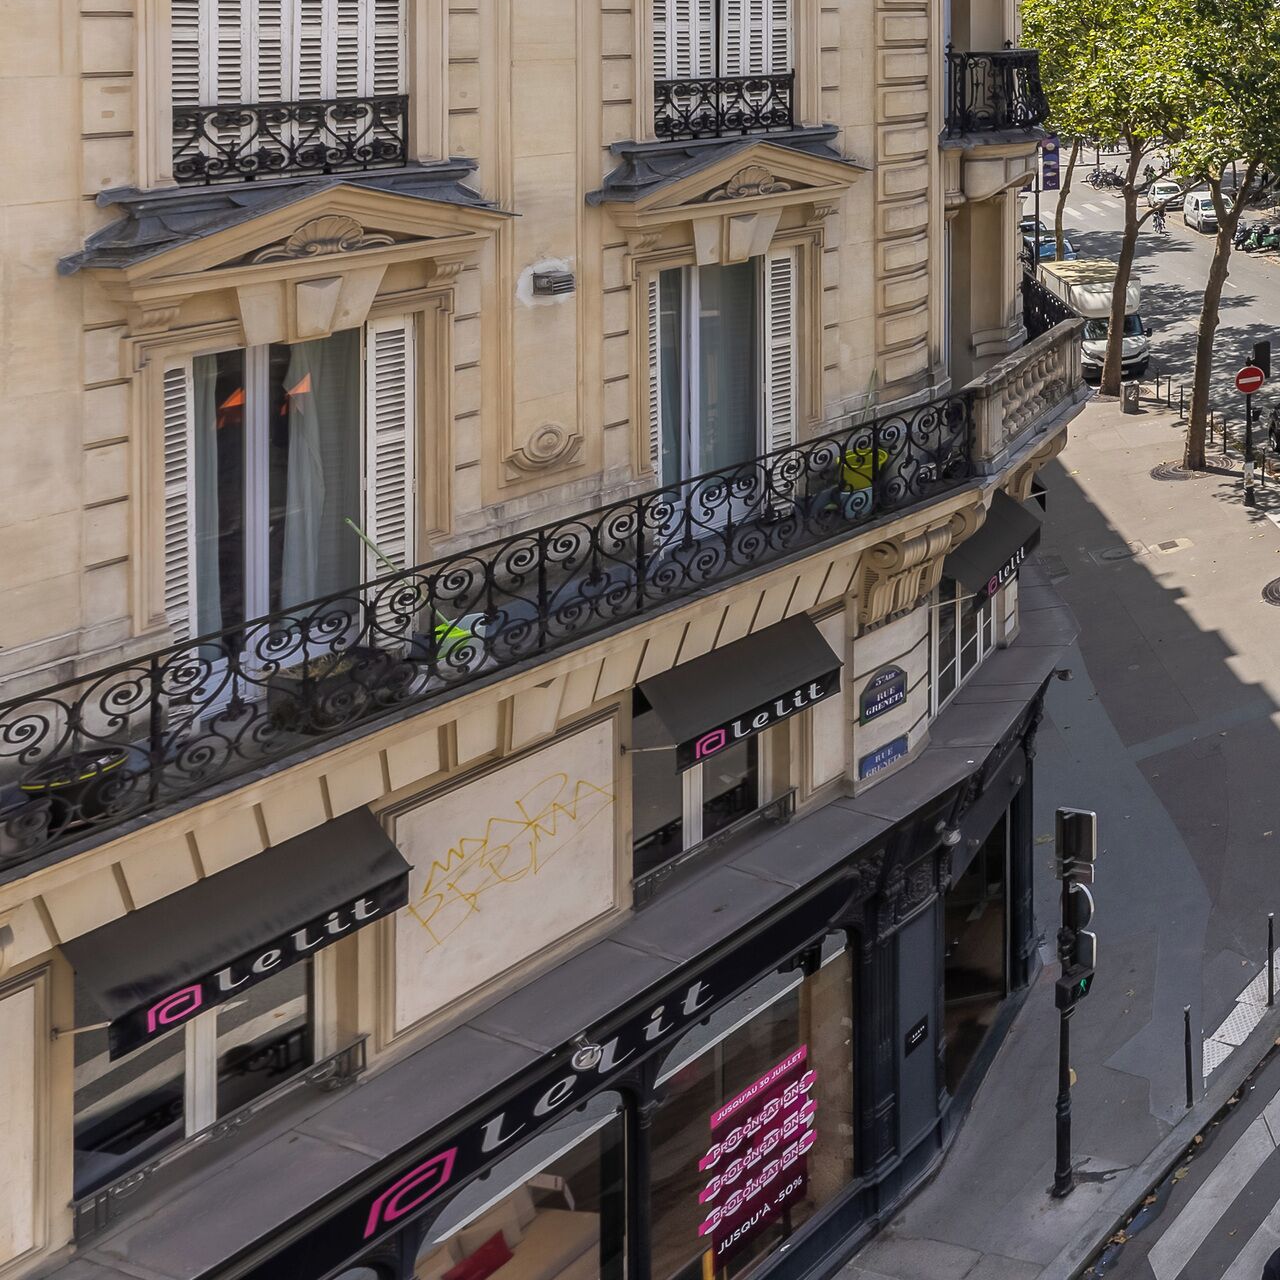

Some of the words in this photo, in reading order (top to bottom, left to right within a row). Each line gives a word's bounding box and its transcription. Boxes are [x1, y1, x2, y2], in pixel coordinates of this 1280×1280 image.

[865, 691, 904, 717] GRENETA
[876, 686, 896, 702] RUE
[874, 747, 894, 763] RUE
[712, 1081, 806, 1159] PROLONGATIONS
[717, 1086, 757, 1121] JUSQU'AU
[759, 1076, 770, 1090] 30
[771, 1051, 803, 1080] JUILLET
[711, 1140, 806, 1223] PROLONGATIONS
[712, 1110, 806, 1191] PROLONGATIONS
[717, 1202, 771, 1256] JUSQU'À
[773, 1175, 804, 1205] -50%
